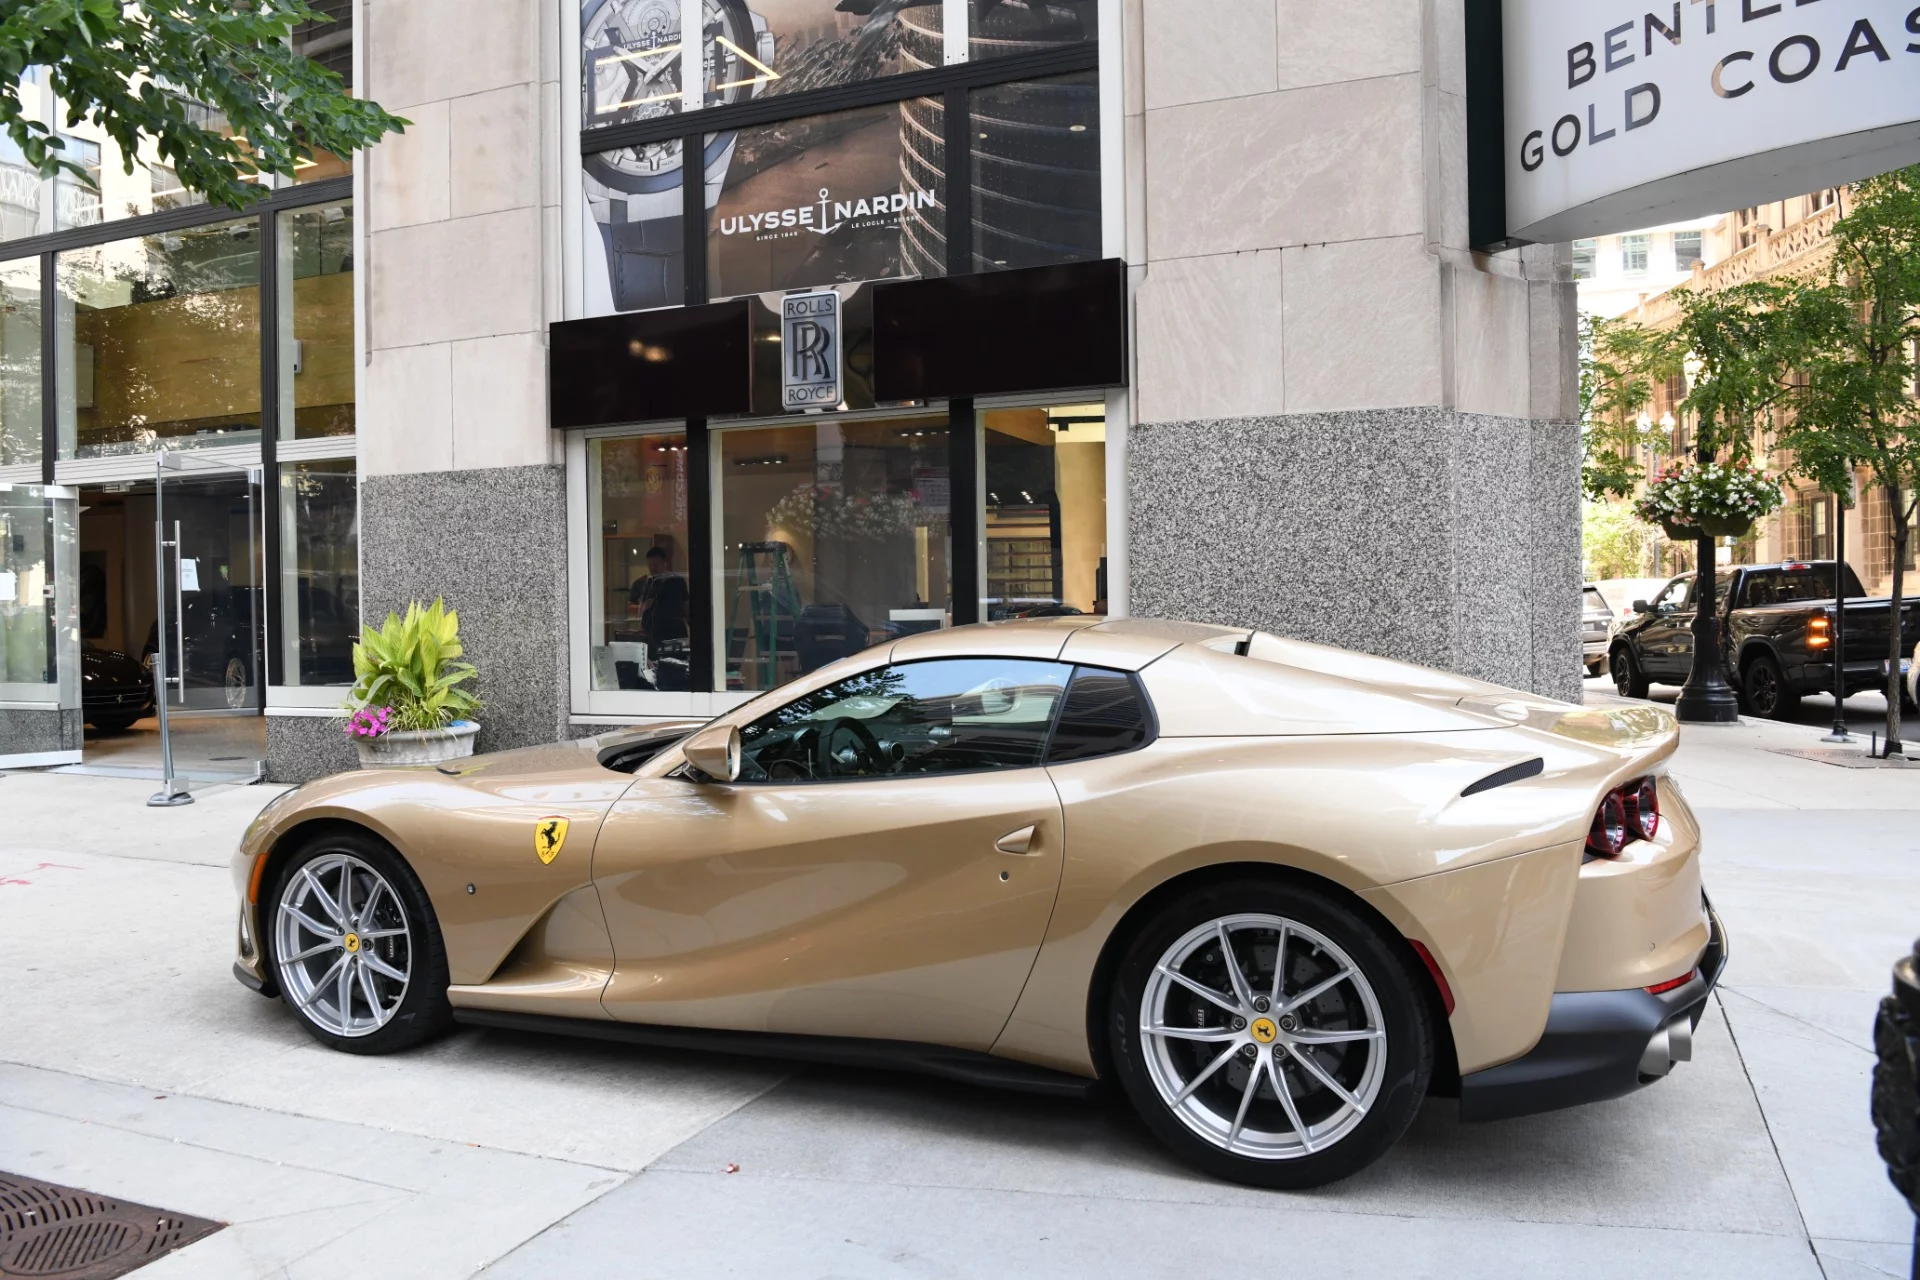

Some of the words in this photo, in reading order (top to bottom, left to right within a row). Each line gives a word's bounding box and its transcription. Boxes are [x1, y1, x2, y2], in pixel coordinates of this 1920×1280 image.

[623, 39, 651, 50] ULYSSE
[657, 33, 681, 44] NARDI
[1568, 0, 1820, 89] BENTL
[1520, 82, 1661, 172] GOLD
[720, 206, 814, 235] ULYSSE
[834, 189, 935, 220] NARDIN
[756, 233, 778, 241] SINCE
[787, 298, 832, 316] ROLLS
[788, 386, 834, 402] ROYCE
